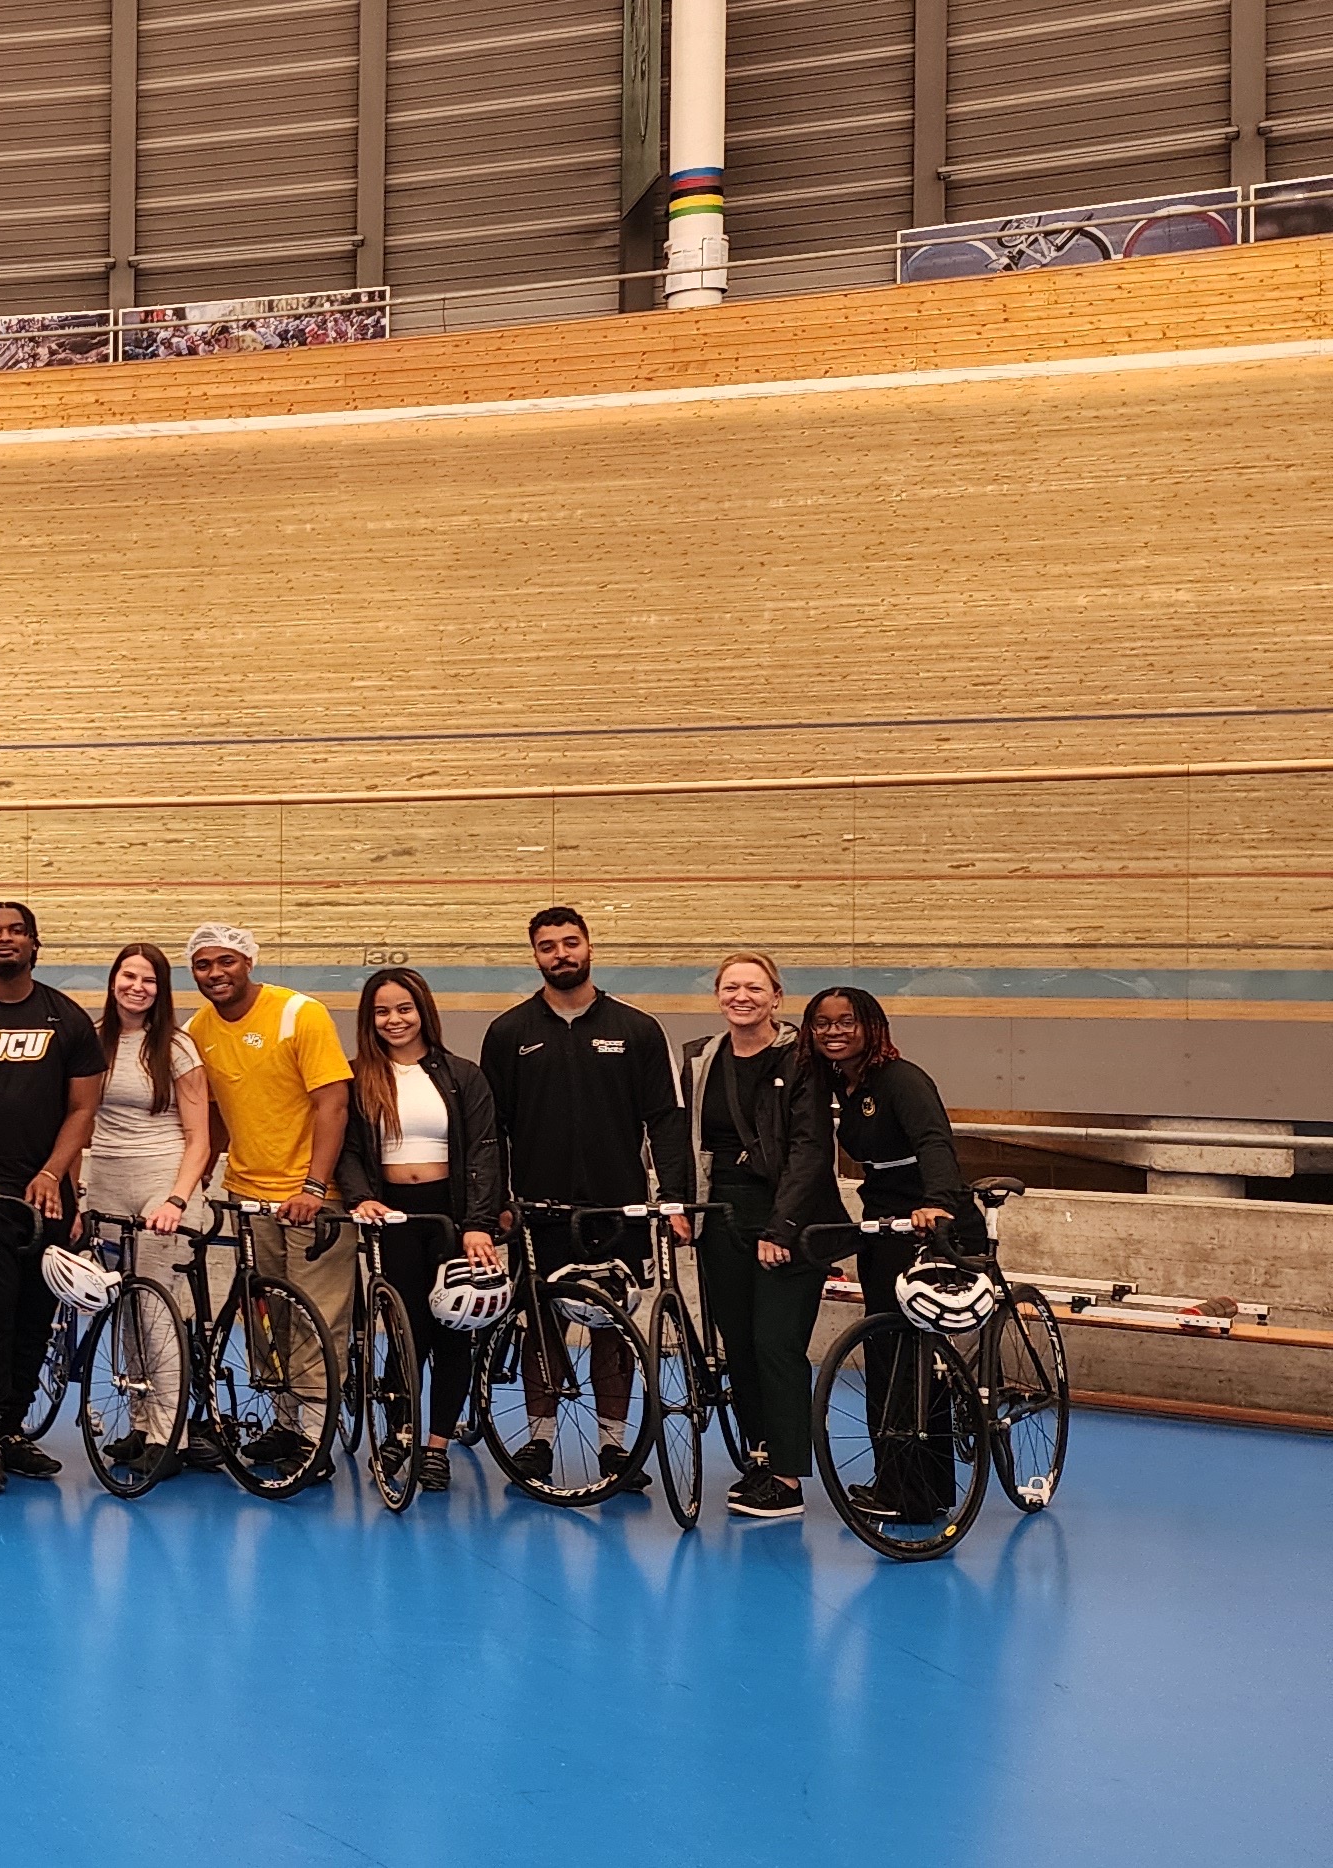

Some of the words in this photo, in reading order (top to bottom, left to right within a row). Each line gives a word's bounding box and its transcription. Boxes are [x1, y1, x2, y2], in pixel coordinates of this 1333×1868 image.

[367, 951, 409, 964] 30
[521, 1225, 536, 1271] LOOK
[662, 1236, 671, 1280] LOOK
